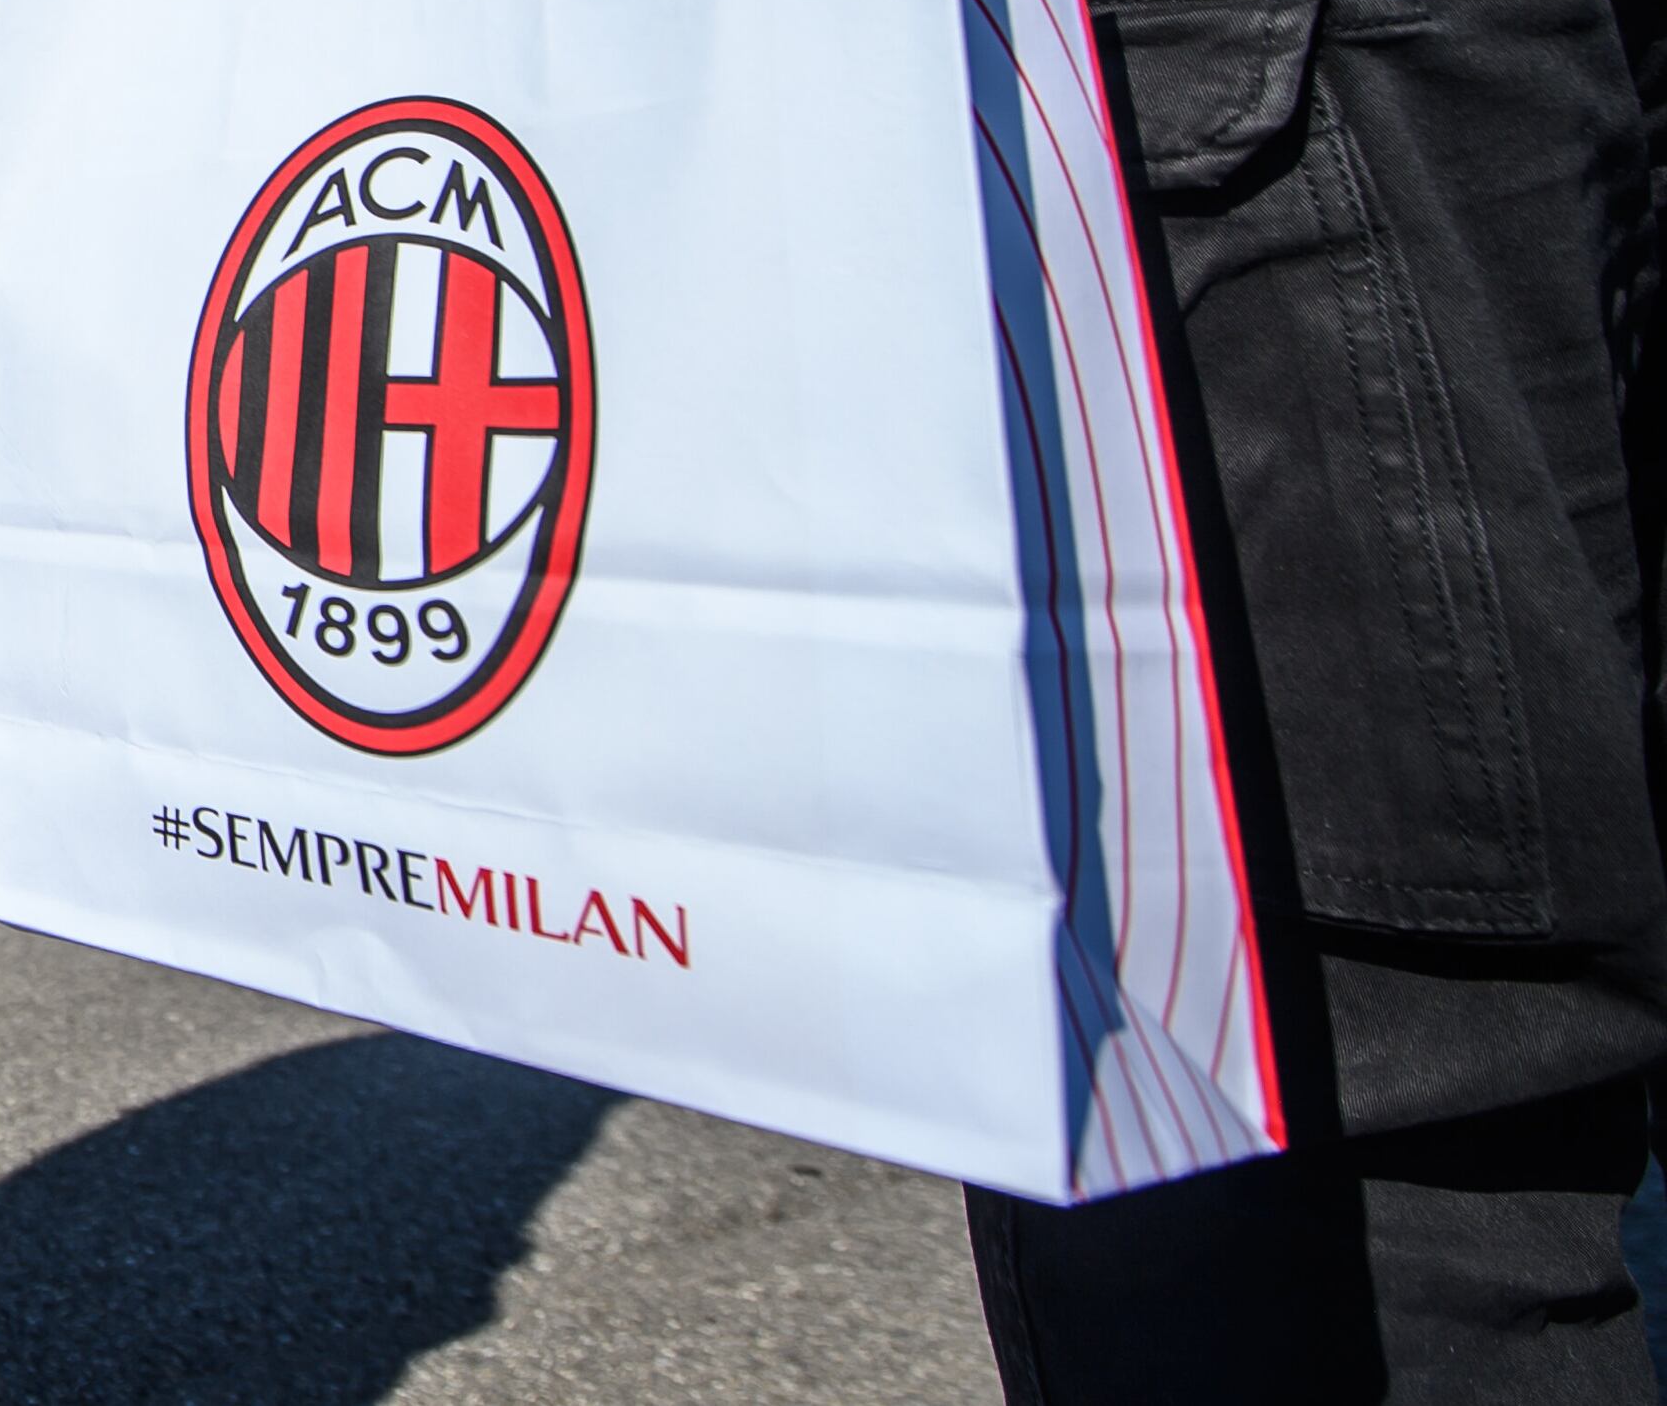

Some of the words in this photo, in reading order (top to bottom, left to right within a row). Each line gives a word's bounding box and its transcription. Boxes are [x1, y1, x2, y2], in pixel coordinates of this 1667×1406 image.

[281, 146, 505, 262] ACM
[279, 582, 471, 667] 1899
[151, 804, 693, 970] #SEMPREMILAN
